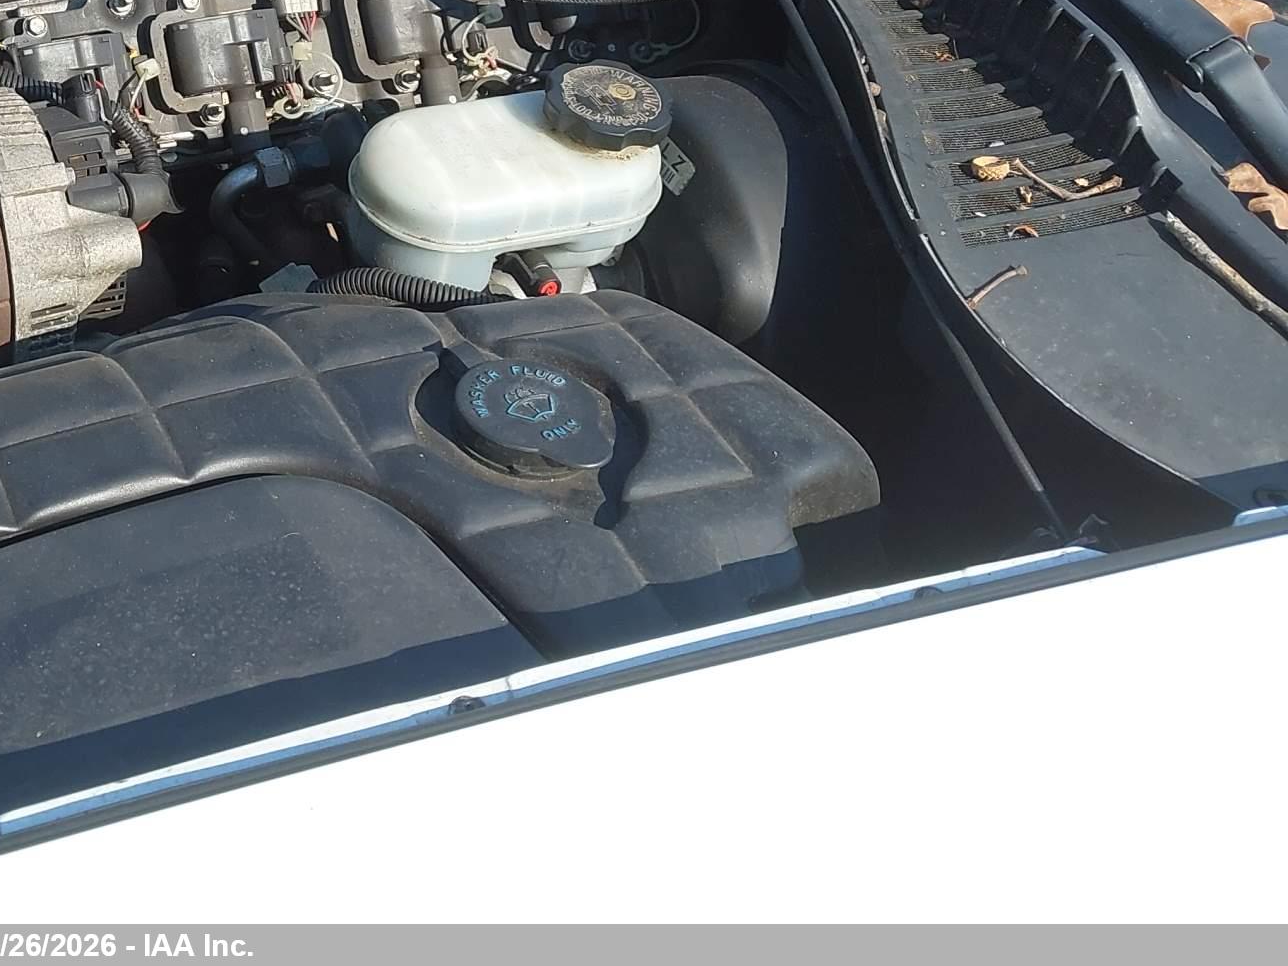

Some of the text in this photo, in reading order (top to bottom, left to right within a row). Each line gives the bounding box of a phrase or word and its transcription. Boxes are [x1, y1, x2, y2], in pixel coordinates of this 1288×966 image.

[468, 365, 567, 418] WASHER FLUID
[540, 418, 583, 442] ONLY
